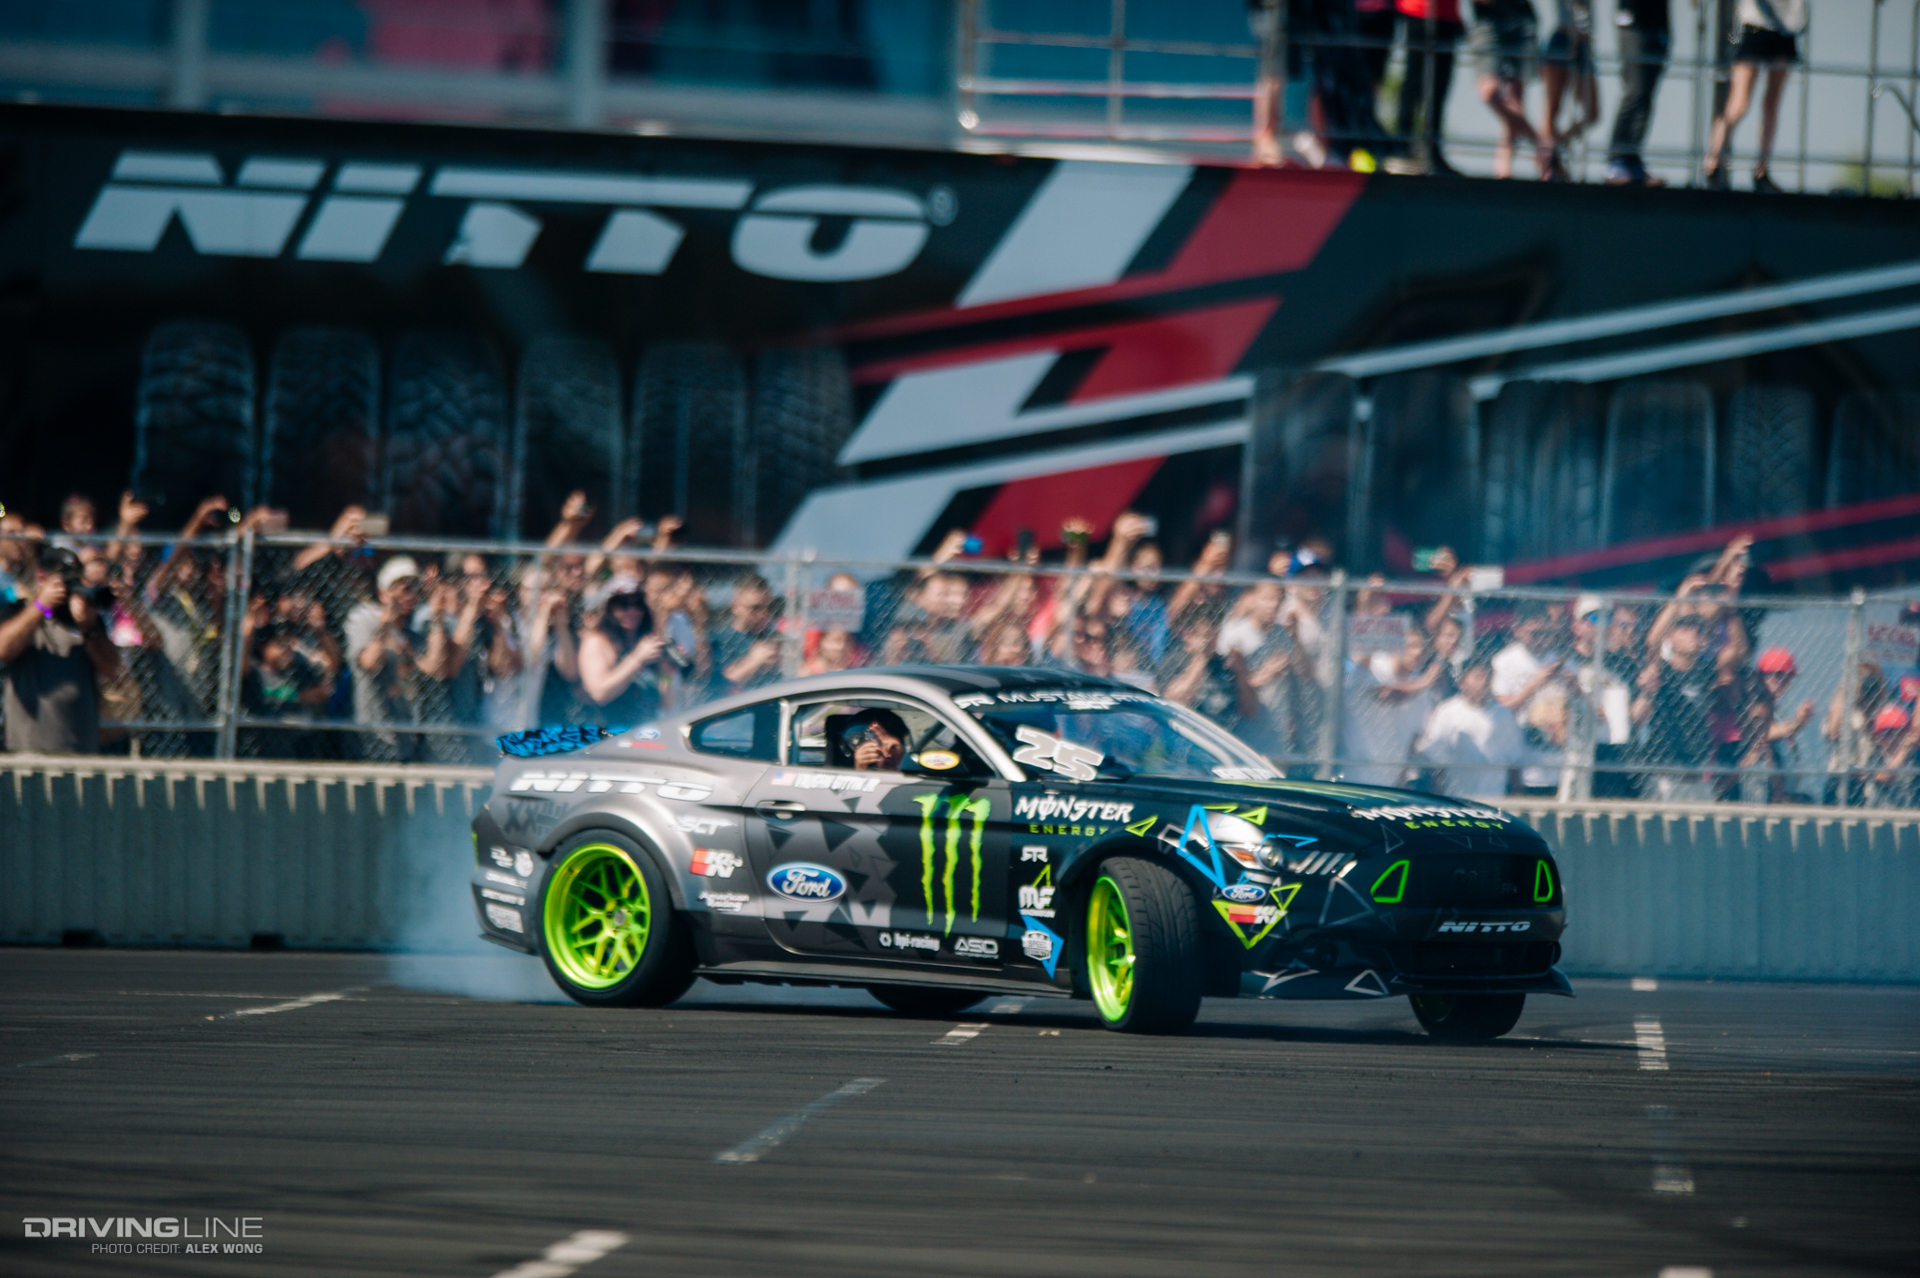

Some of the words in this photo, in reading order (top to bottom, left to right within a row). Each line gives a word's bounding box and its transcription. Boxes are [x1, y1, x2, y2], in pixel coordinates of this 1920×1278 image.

[74, 150, 931, 282] NITTO
[1012, 724, 1105, 782] 25
[509, 773, 713, 802] NITTO
[1014, 795, 1135, 824] MONSTER
[1029, 823, 1109, 837] ENERGY
[1404, 819, 1504, 830] ENERGY
[781, 868, 832, 897] Ford
[1230, 887, 1259, 899] Ford
[1438, 921, 1531, 932] NITTO
[954, 937, 999, 954] ASD
